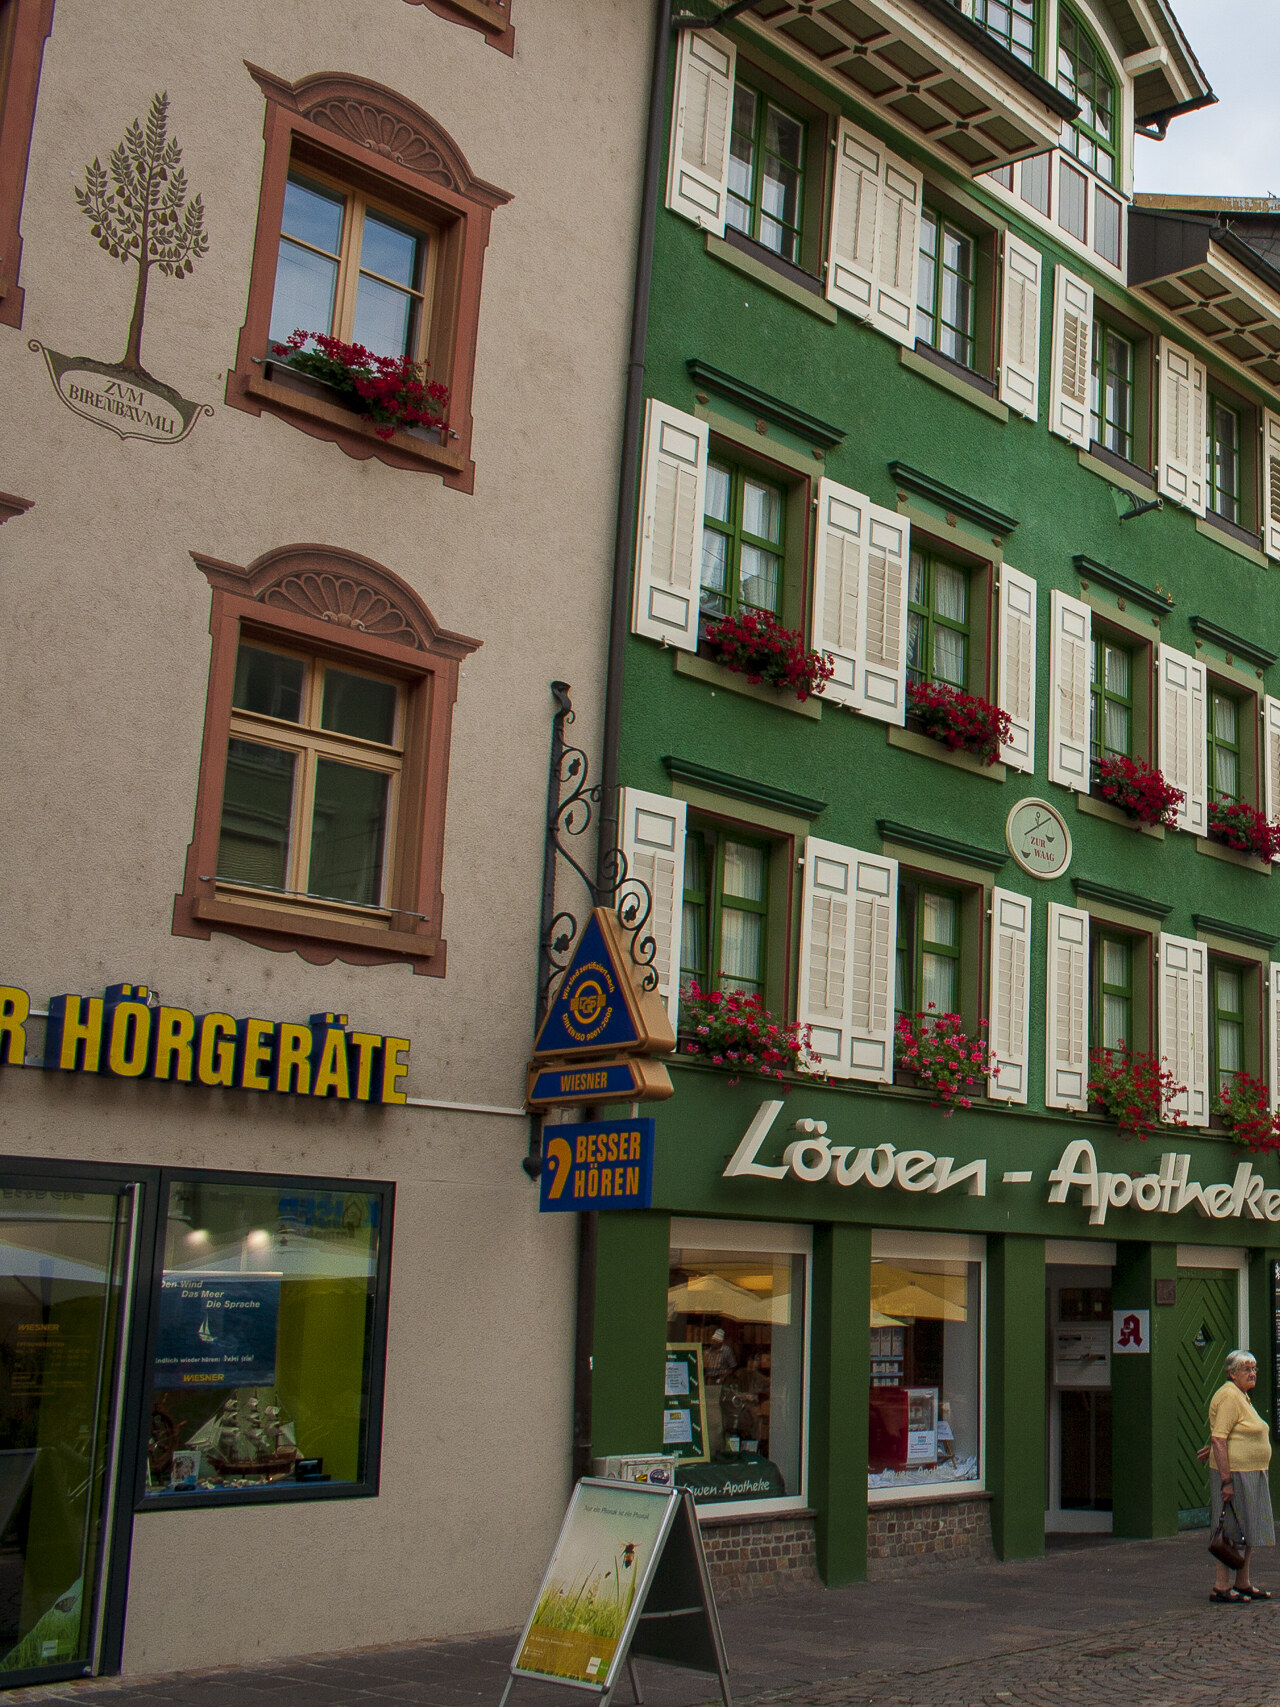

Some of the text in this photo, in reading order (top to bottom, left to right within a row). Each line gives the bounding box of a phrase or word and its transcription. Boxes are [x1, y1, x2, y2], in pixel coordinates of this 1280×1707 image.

[1030, 836, 1046, 848] ZUR
[1034, 848, 1055, 861] WAAG
[575, 1032, 586, 1041] ISO
[56, 982, 411, 1105] HÖRGERÄTE
[560, 1071, 608, 1092] WIESNER
[575, 1131, 641, 1163] BESSER
[722, 1099, 987, 1196] Löwen
[574, 1163, 640, 1198] HÖREN
[180, 1280, 203, 1289] Wind
[181, 1290, 224, 1298] Das Meer
[206, 1300, 260, 1309] Die Sprache
[183, 1373, 225, 1382] WIESNER
